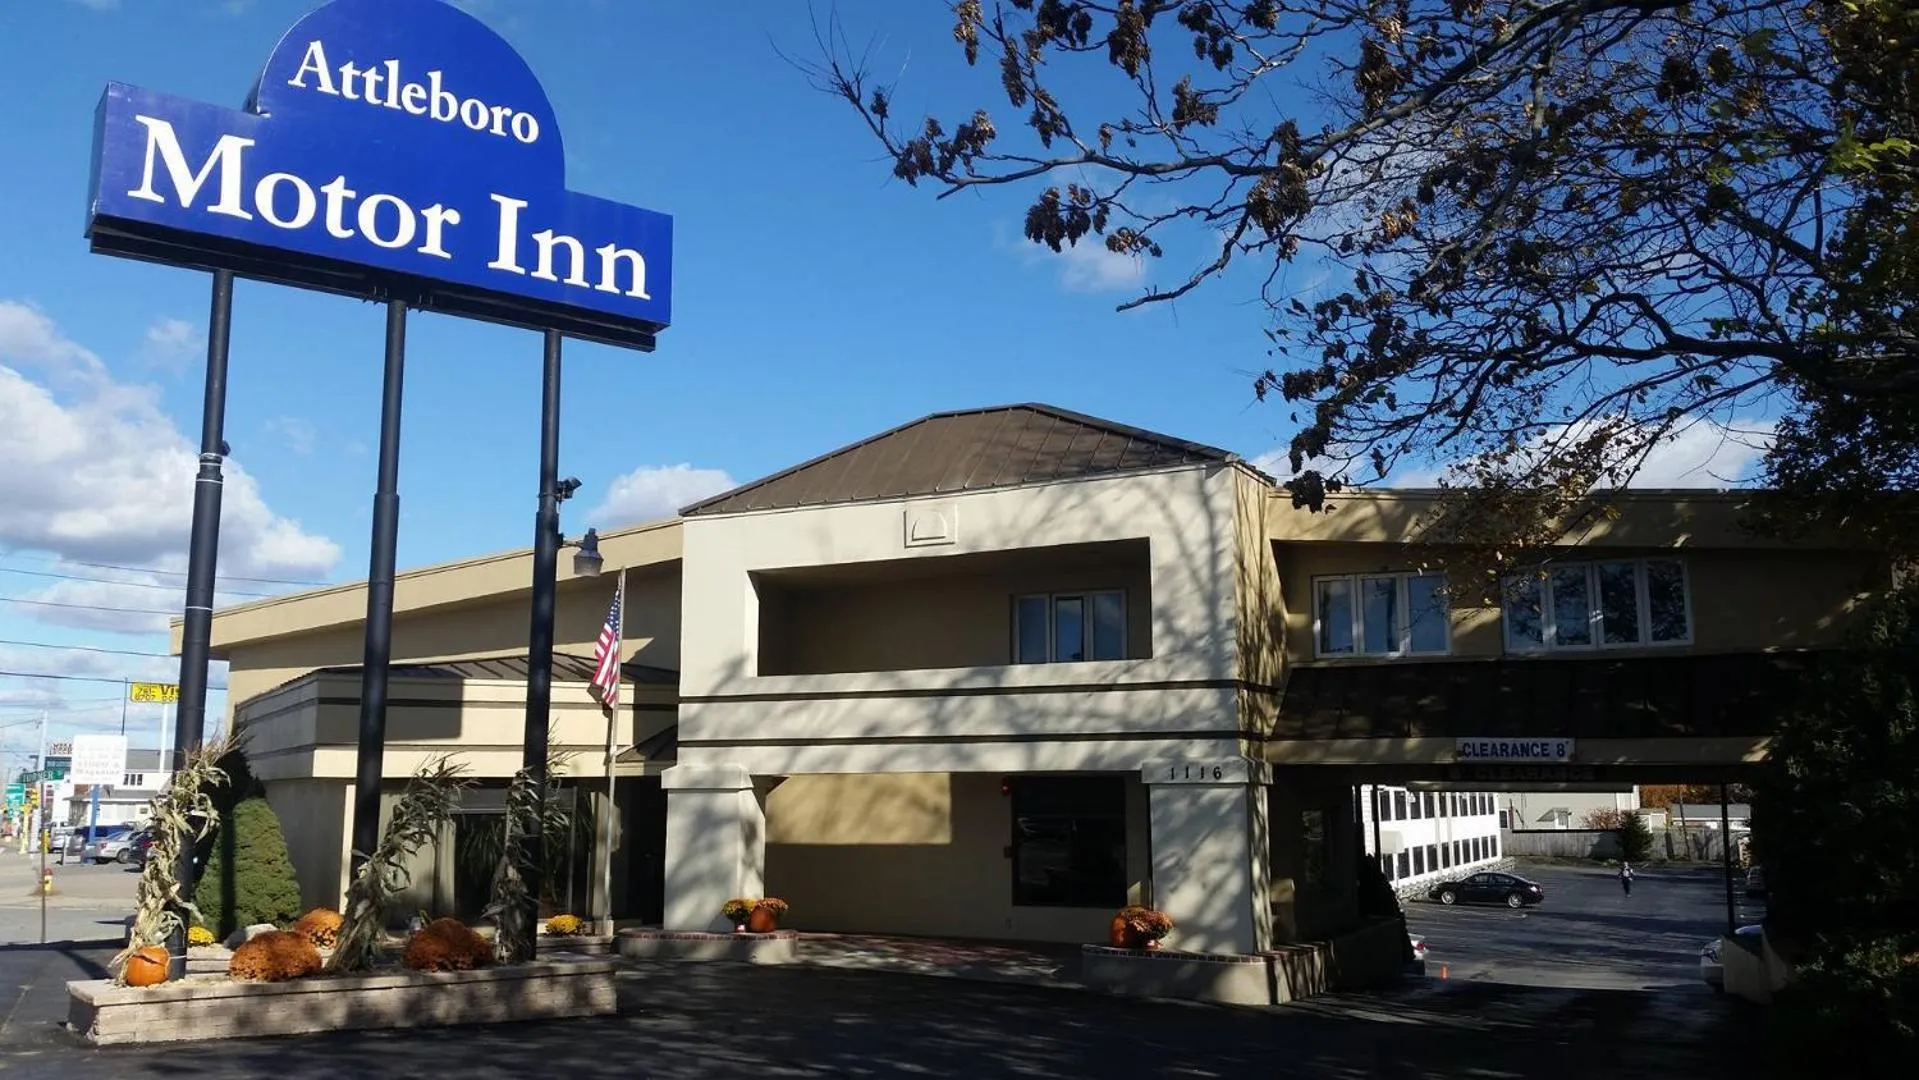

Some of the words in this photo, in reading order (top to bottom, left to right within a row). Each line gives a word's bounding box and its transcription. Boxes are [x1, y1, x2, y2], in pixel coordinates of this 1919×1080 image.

[288, 40, 539, 144] Attleboro
[127, 114, 460, 259] Motor
[487, 193, 651, 300] Inn
[1171, 765, 1222, 780] 1116
[1462, 742, 1549, 757] CLEARANCE
